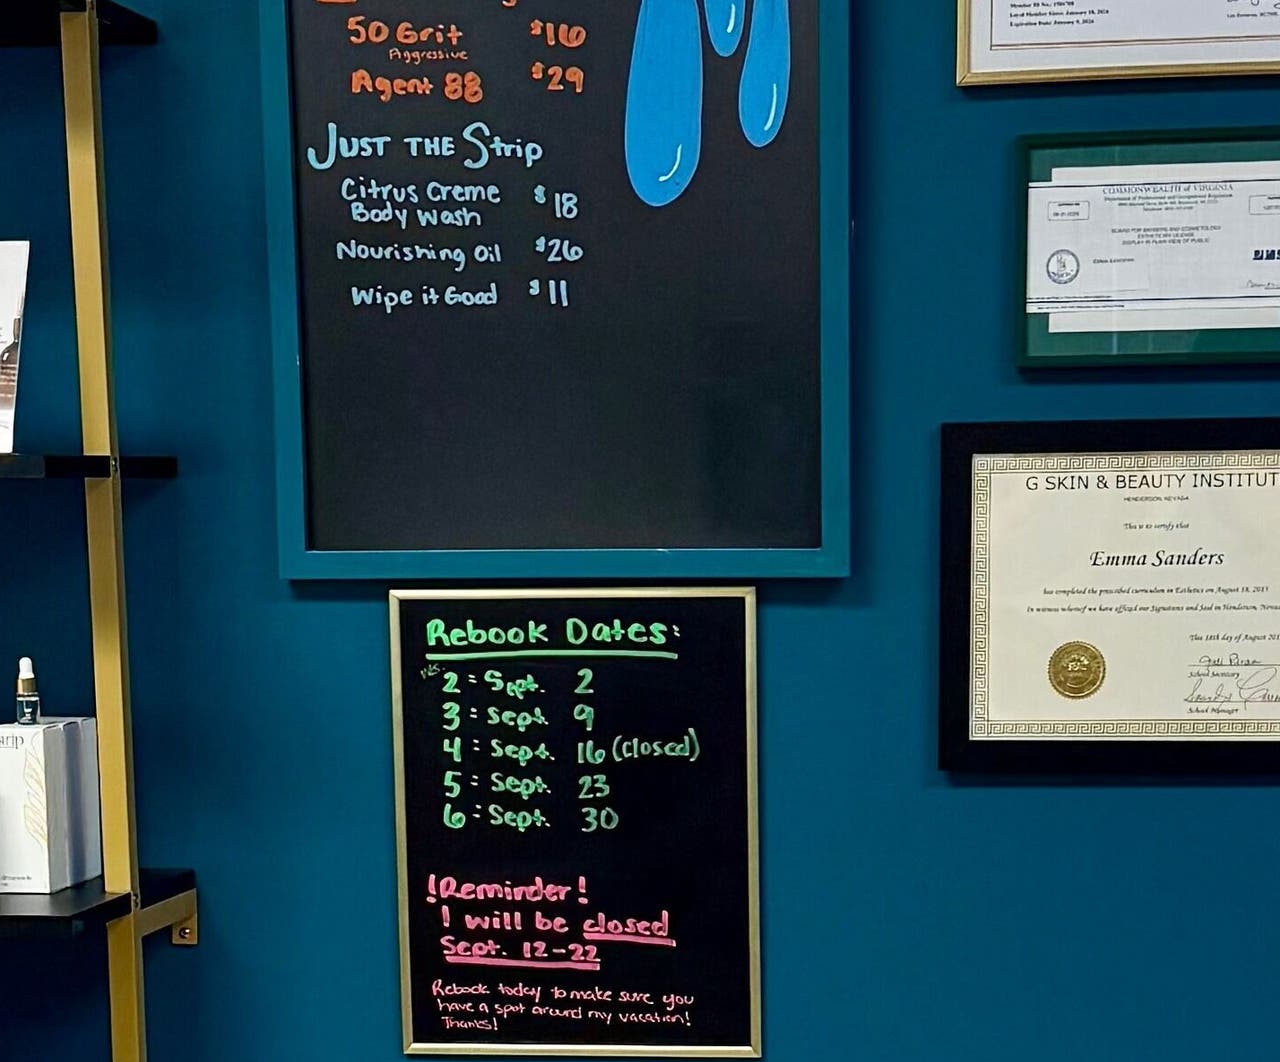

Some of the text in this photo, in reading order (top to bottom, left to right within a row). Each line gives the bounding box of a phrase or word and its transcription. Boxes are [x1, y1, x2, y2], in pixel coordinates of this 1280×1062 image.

[347, 15, 588, 48] 50 Grit $16
[389, 48, 468, 64] Aggressive
[350, 62, 585, 103] Agent 88 $29
[403, 135, 456, 157] THE
[462, 121, 543, 168] Strip
[341, 176, 418, 202] Citrus
[351, 201, 407, 229] Body
[336, 235, 584, 272] Nourishing Oil $26
[352, 285, 413, 314] Wipe
[422, 285, 439, 306] it
[444, 282, 498, 306] Good
[1025, 475, 1038, 490] G
[1045, 475, 1089, 490] SKIN
[1096, 474, 1109, 490] &
[1116, 473, 1186, 489] BEAUTY
[1089, 547, 1225, 567] Emma Sanders
[425, 617, 681, 647] Rebook Dates:
[442, 671, 461, 693] 2
[574, 668, 595, 694] 2
[442, 701, 461, 731] 3
[573, 704, 595, 731] 9
[443, 736, 462, 762] 4
[577, 740, 605, 764] 16
[612, 727, 701, 763] (closed)
[443, 771, 462, 798] 5
[578, 774, 610, 799] 23
[443, 803, 466, 829] 6
[581, 807, 620, 832] 30
[464, 910, 521, 931] will
[535, 911, 569, 933] be
[583, 910, 669, 936] closed
[440, 936, 508, 956] Sept.
[432, 979, 694, 1010] Rebook today to make sure you
[437, 999, 692, 1027] have a spot around my vacation!
[440, 1016, 498, 1031] Thanks!
